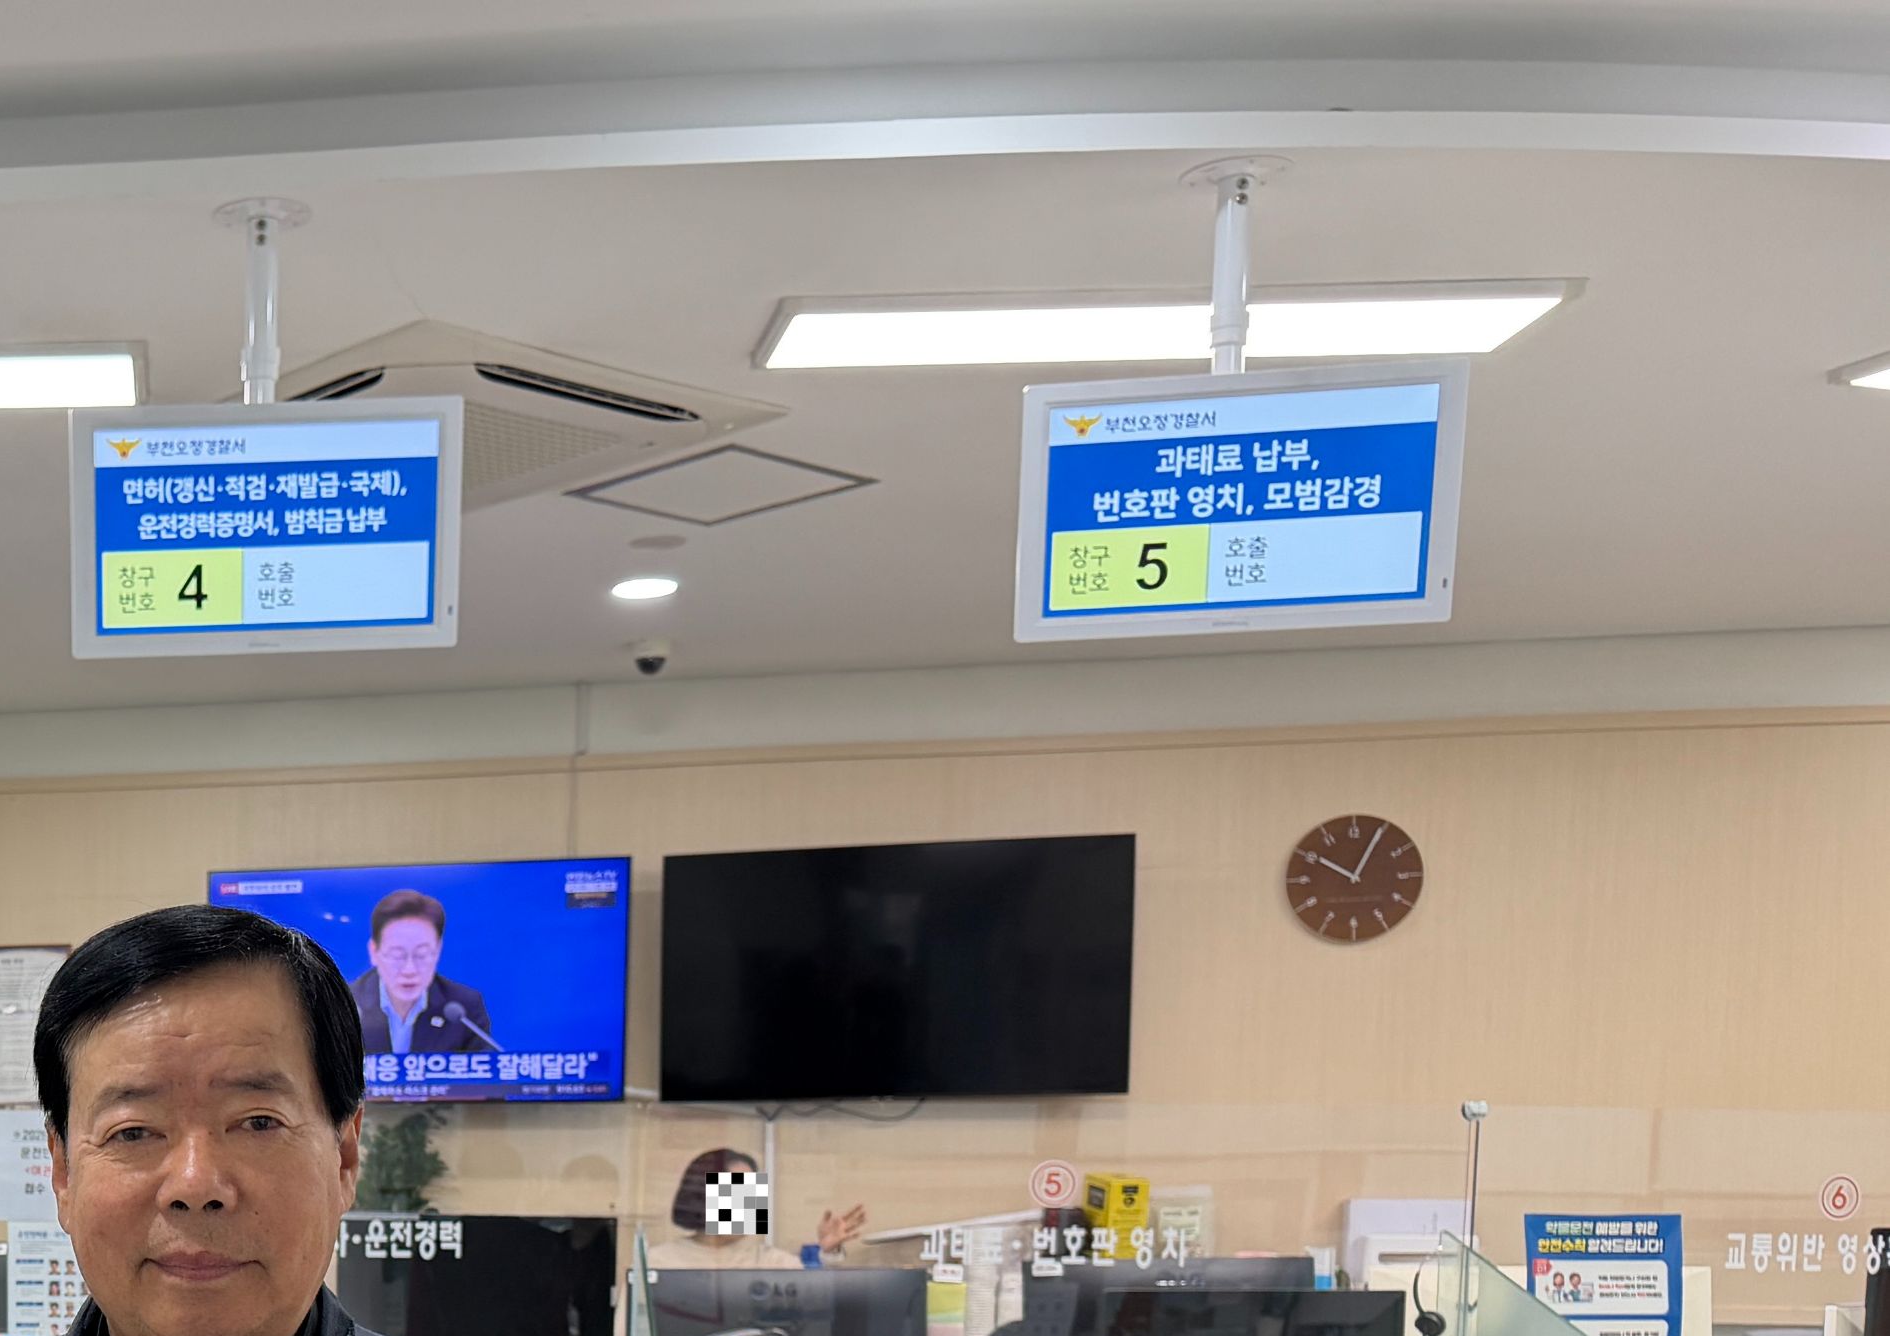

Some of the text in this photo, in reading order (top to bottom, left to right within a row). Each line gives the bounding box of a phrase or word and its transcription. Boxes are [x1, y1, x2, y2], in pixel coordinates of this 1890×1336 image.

[1155, 439, 1320, 477] 과태료 납부,
[1093, 475, 1381, 522] 번호판 영치, 모범감경
[137, 506, 387, 540] 운전경력증명서, 범칙금 납부
[178, 564, 207, 610] 4
[1136, 542, 1168, 590] 5
[1725, 1232, 1824, 1272] 교통위반
